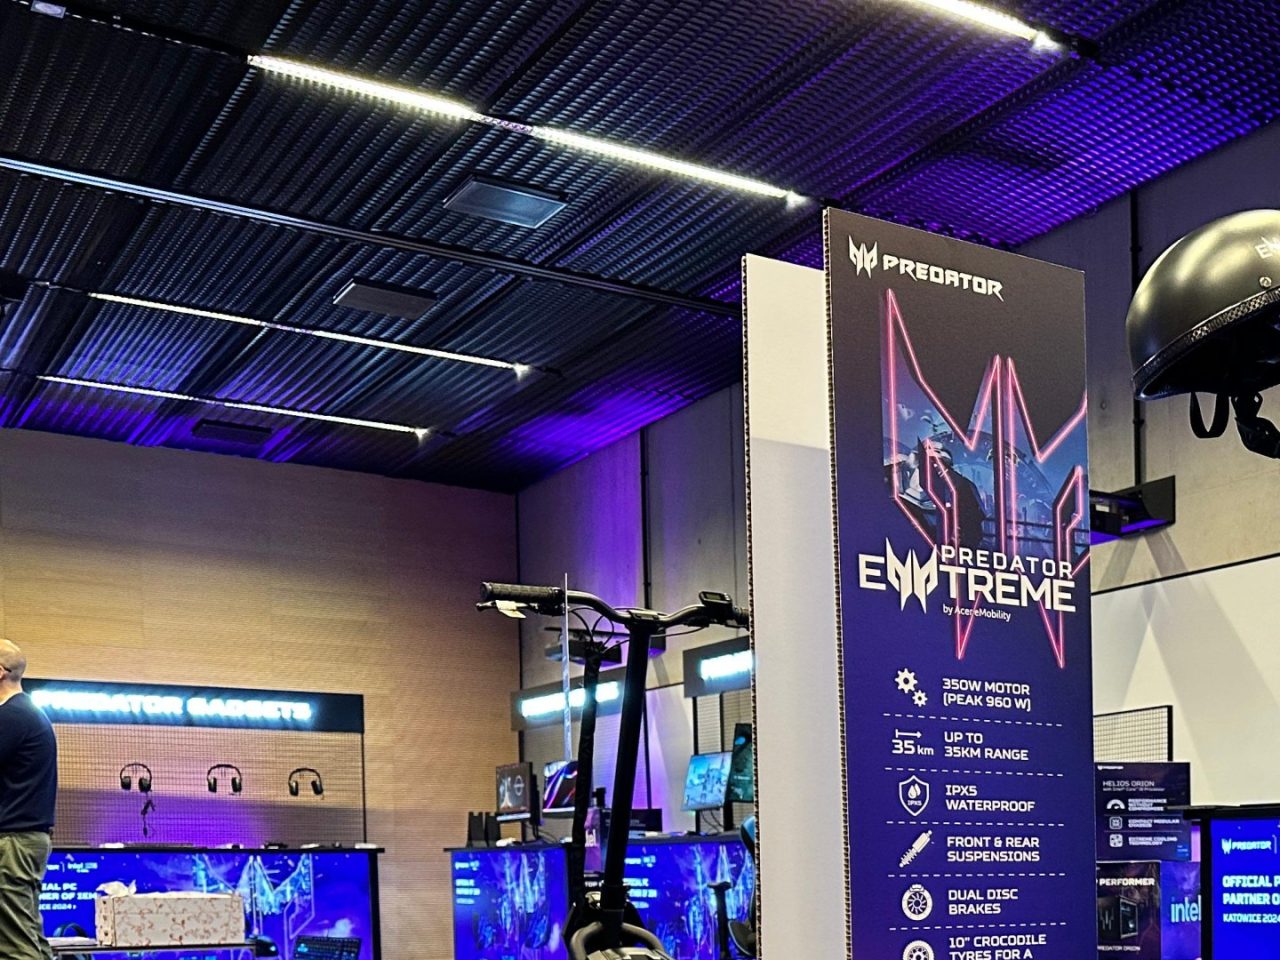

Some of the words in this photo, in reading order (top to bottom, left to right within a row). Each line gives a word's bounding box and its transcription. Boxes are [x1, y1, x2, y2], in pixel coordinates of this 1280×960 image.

[883, 253, 1005, 301] PREDATOR
[941, 544, 1073, 579] PREDATOR
[943, 603, 953, 616] by
[942, 678, 981, 692] 350W
[984, 681, 1031, 696] MOTOR
[943, 692, 983, 707] (PEAK
[985, 696, 1012, 709] 960
[1014, 698, 1031, 712] W)
[944, 731, 963, 743] UP
[965, 732, 984, 744] TO
[892, 739, 916, 755] 35
[917, 745, 934, 756] km
[944, 746, 981, 758] 35KM
[984, 748, 1029, 760] RANGE
[945, 784, 978, 797] IPX5
[1102, 780, 1130, 788] HELIOS
[945, 799, 1035, 812] WATERPROOF
[947, 836, 991, 848] FRONT
[994, 837, 1003, 848] &
[1005, 837, 1040, 848] REAR
[947, 851, 1040, 862] SUSPENSIONS
[1099, 877, 1156, 887] PERFORMER
[1222, 875, 1273, 888] OFFICIAL
[948, 889, 984, 901] DUAL
[987, 888, 1018, 900] DISC
[1222, 893, 1271, 905] PARTNER
[948, 903, 1001, 915] BRAKES
[1223, 913, 1262, 923] KATOWICE
[973, 933, 1047, 948] CROCODILE
[995, 949, 1020, 960] FOR
[1023, 948, 1033, 959] A
